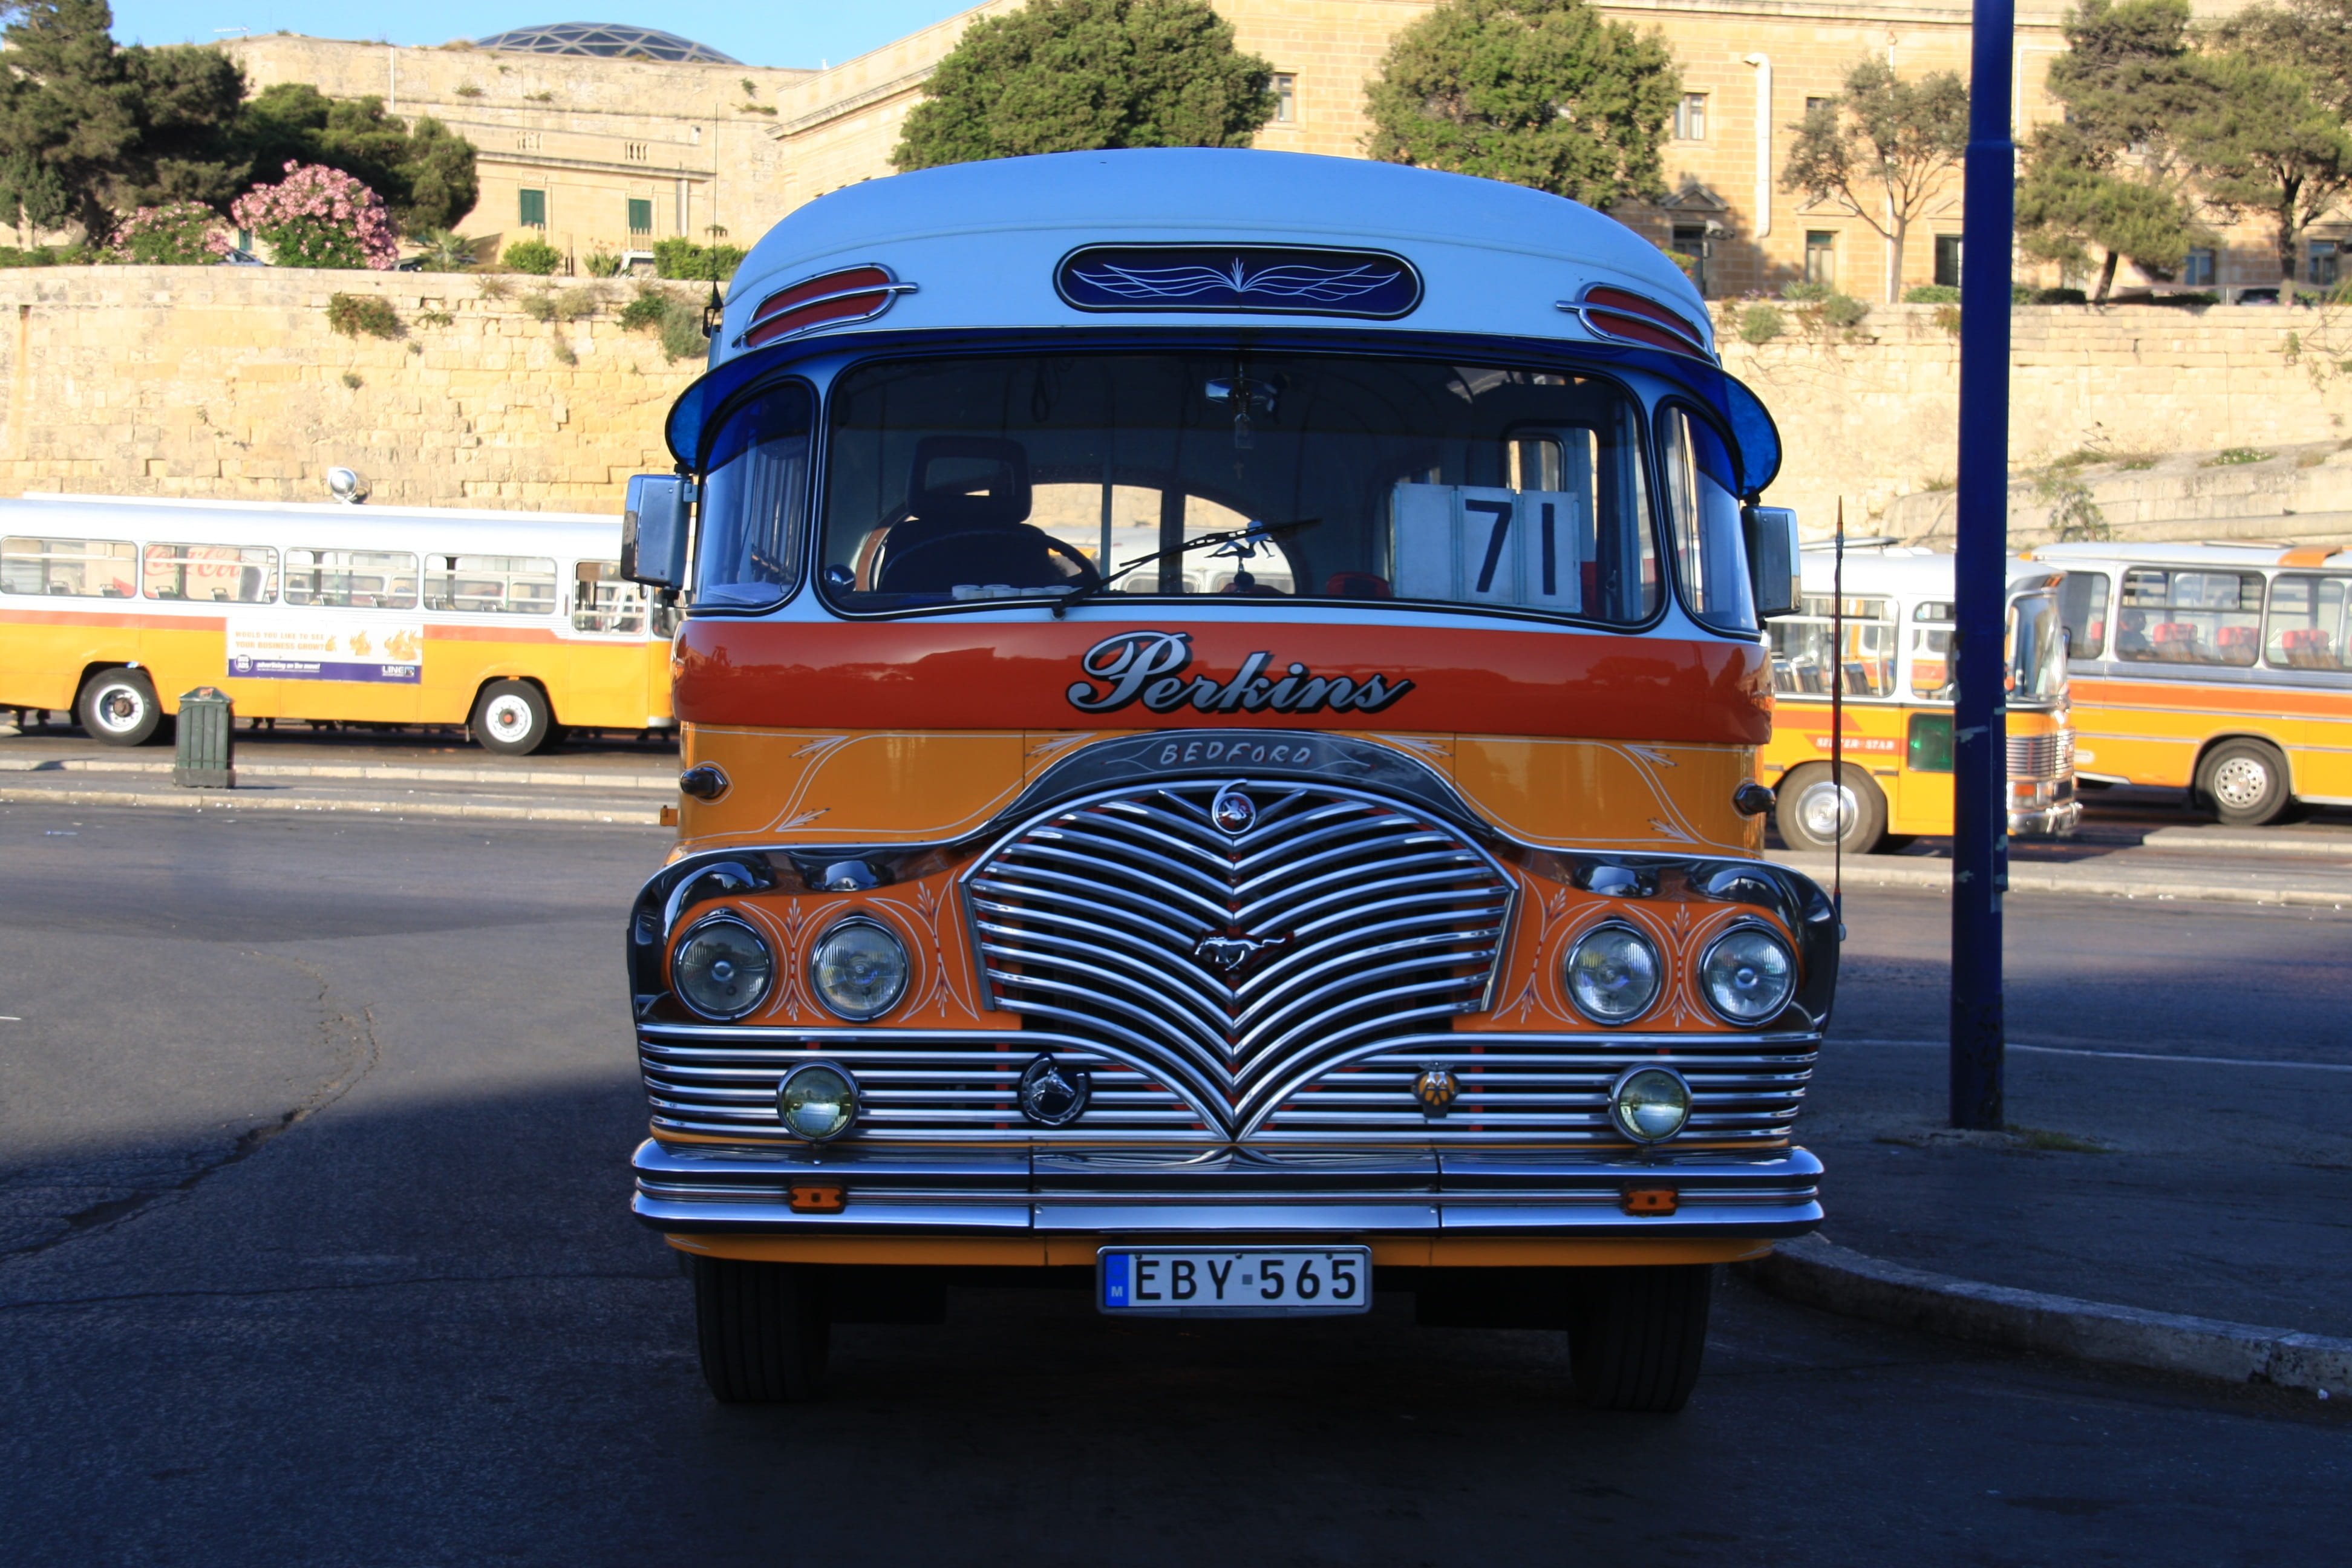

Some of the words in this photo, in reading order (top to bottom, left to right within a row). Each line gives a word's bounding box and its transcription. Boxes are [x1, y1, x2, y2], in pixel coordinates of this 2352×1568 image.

[1465, 498, 1557, 596] 71
[1067, 630, 1416, 714] Perkins
[1160, 741, 1313, 766] BEDFORD
[1865, 740, 1895, 750] STAR
[1111, 1286, 1123, 1298] M
[1136, 1259, 1233, 1301] EBY
[1260, 1259, 1356, 1300] 565
